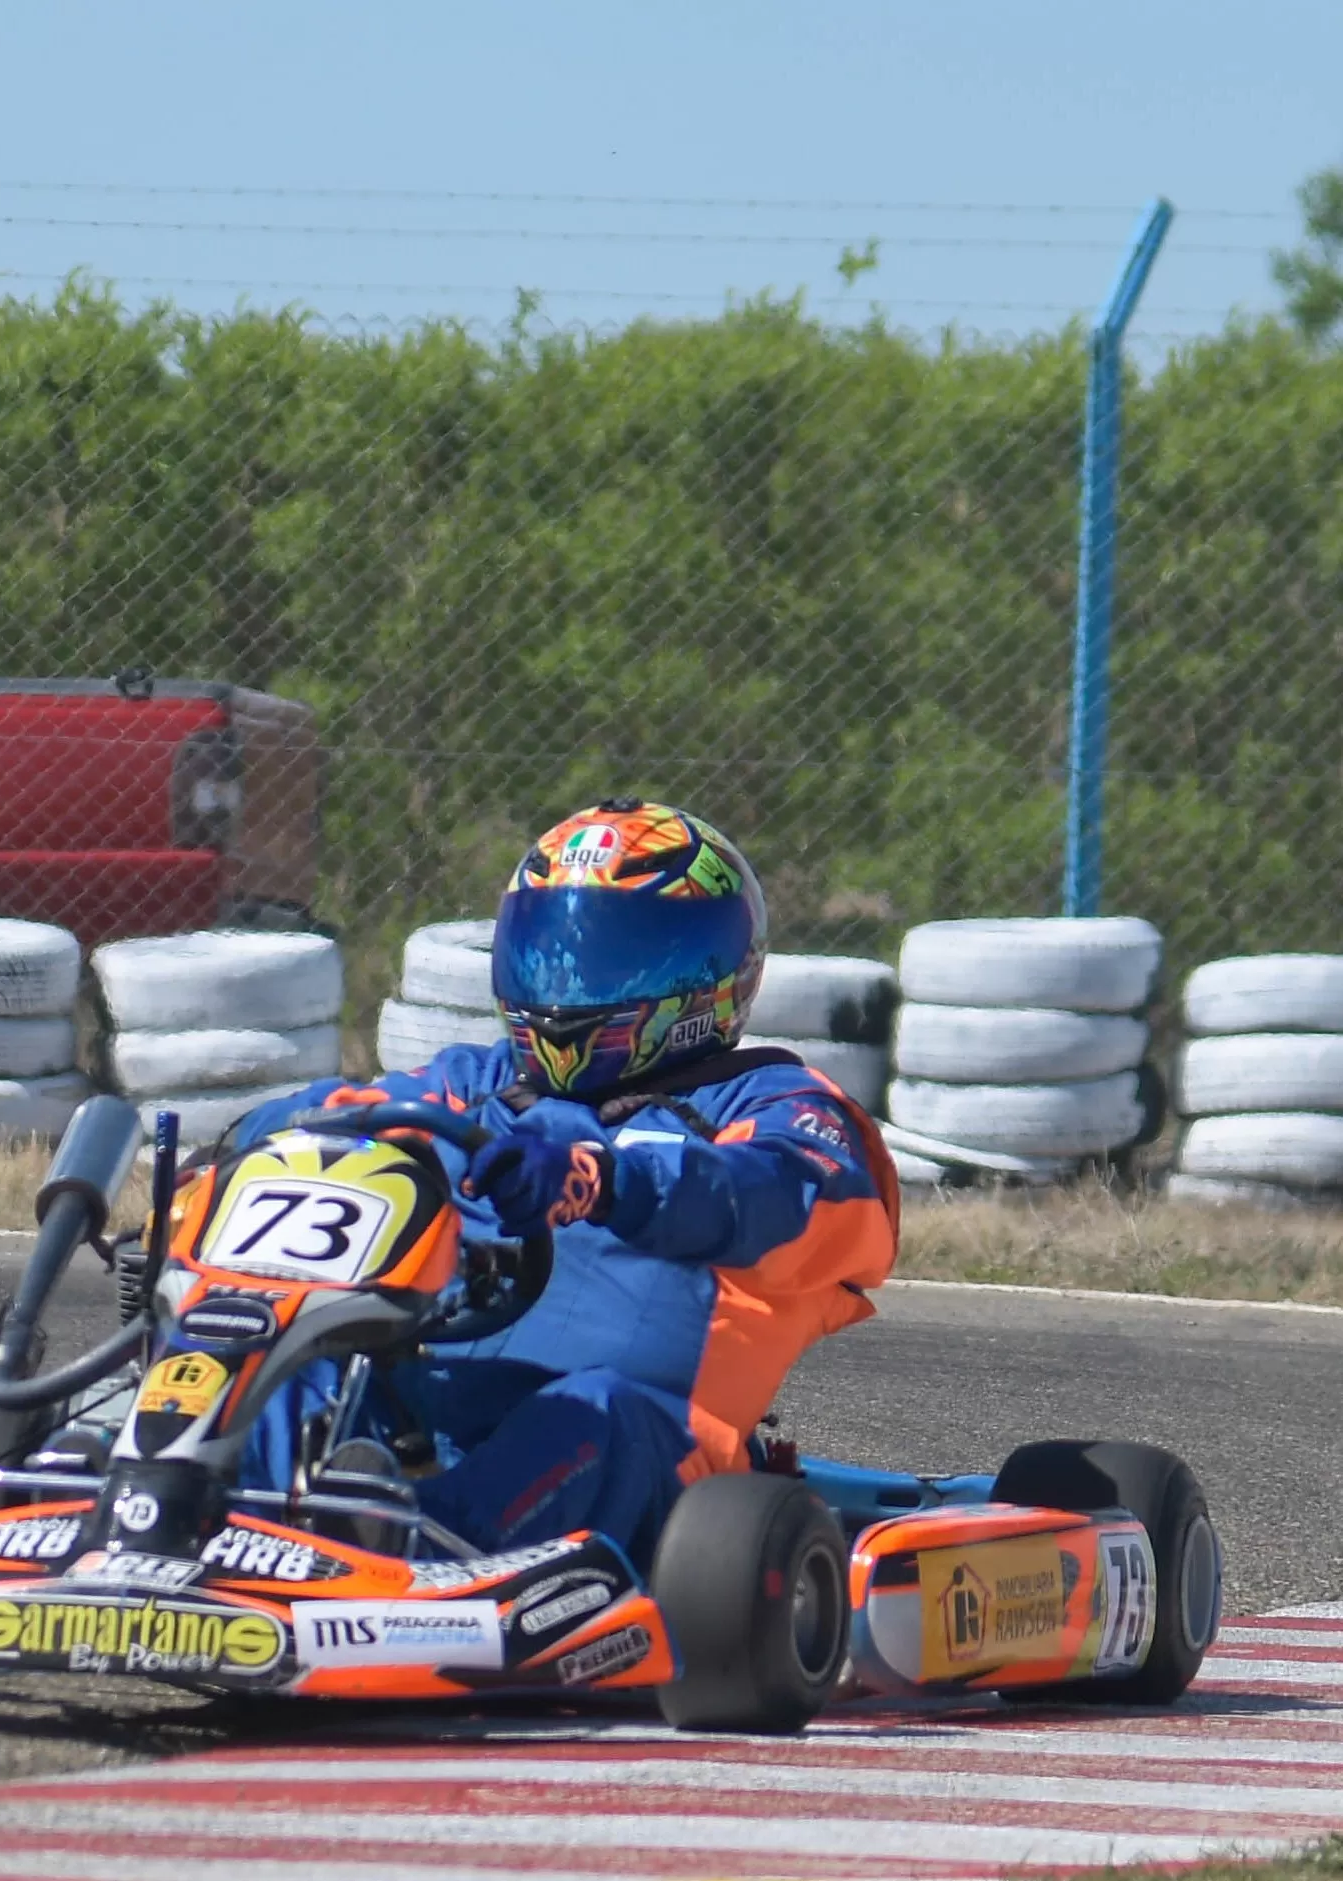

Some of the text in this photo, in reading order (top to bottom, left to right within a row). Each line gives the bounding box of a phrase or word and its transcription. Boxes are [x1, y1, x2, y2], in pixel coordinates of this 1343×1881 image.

[232, 1192, 363, 1261] 73
[1106, 1543, 1148, 1658] 73
[68, 1643, 109, 1674] By
